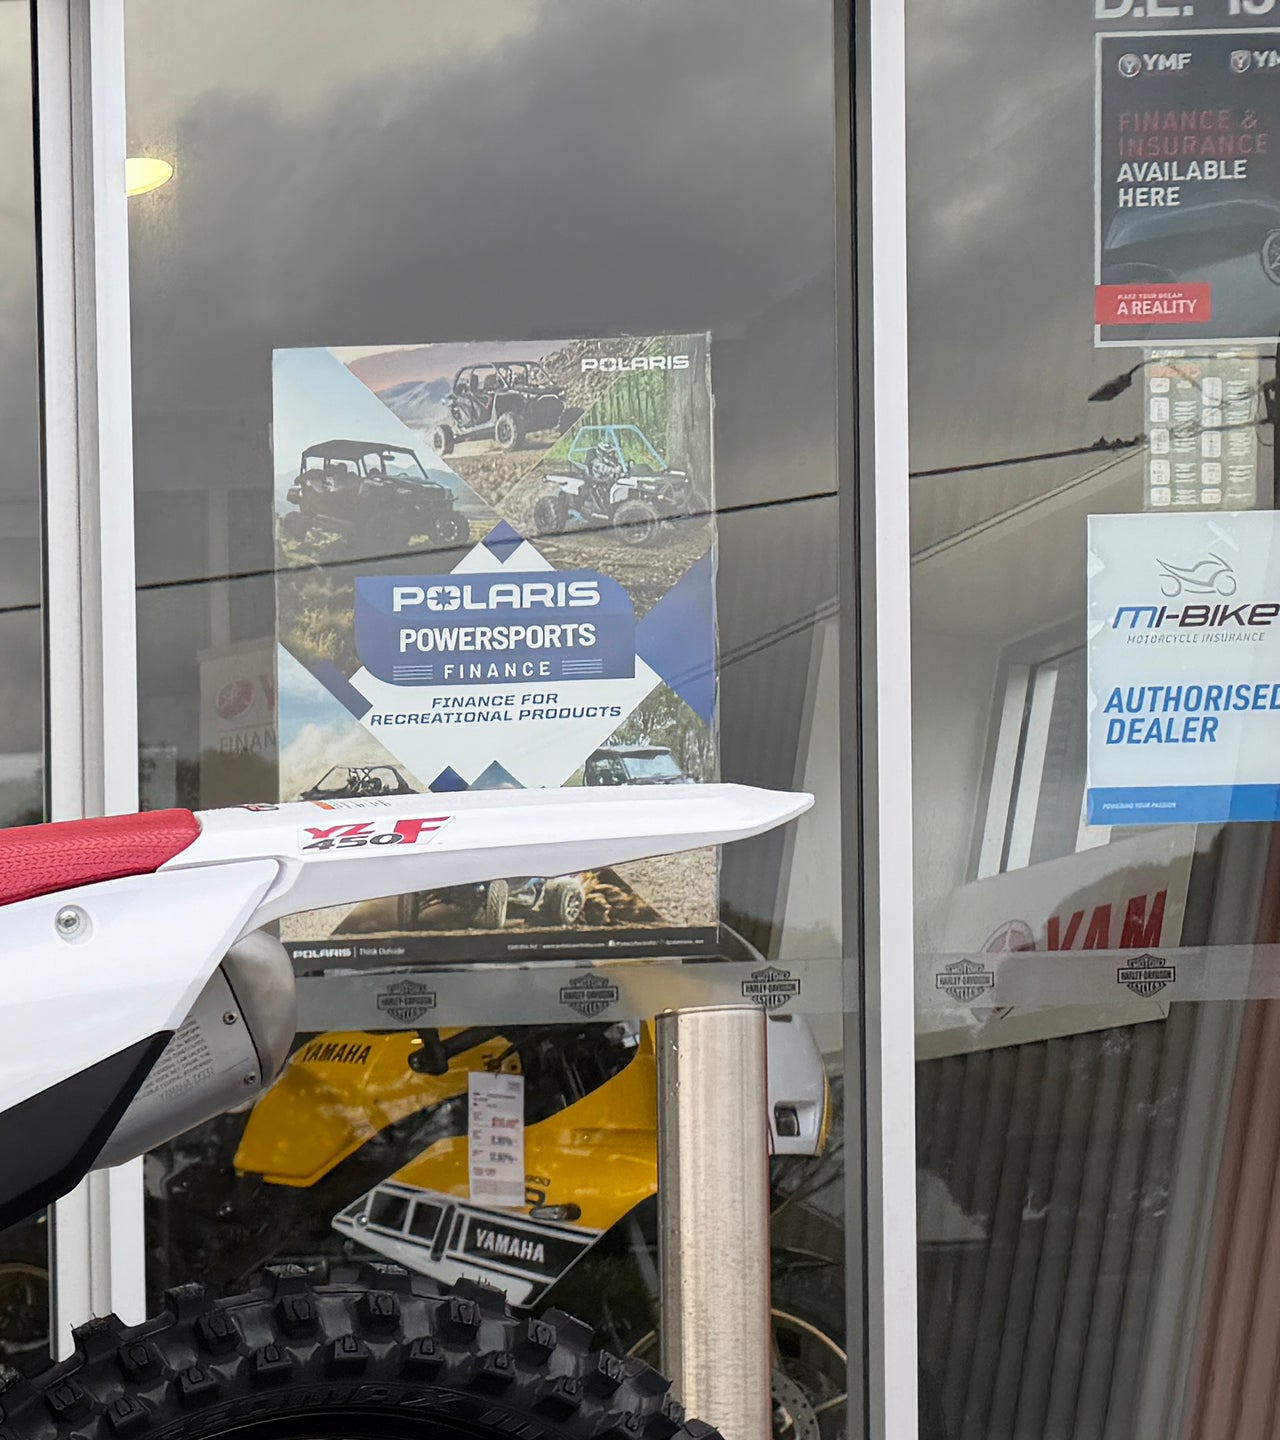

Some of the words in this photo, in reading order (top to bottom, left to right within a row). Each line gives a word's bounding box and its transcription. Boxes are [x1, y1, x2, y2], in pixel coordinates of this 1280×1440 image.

[1143, 53, 1192, 71] YMF
[1118, 110, 1230, 132] FINANCE
[1241, 109, 1258, 129] &
[1118, 133, 1269, 157] INSURANCE
[1116, 160, 1247, 183] AVAILABLE
[1118, 186, 1180, 207] HERE
[1117, 301, 1128, 316] A
[1132, 299, 1197, 316] REALITY
[581, 354, 690, 373] POLARIS
[393, 581, 601, 612] POLARIS
[399, 623, 597, 653] POWERSPORTS
[1127, 633, 1200, 644] MOTORCYCLE
[1202, 632, 1266, 643] INSURANCE
[444, 661, 552, 679] FINANCE
[431, 694, 516, 709] FINANCE
[521, 692, 559, 706] FOR
[370, 708, 513, 727] RECREATIONAL
[519, 705, 621, 721] PRODUCTS
[1106, 716, 1219, 744] DEALER
[293, 948, 352, 959] POLARIS
[302, 1042, 371, 1065] YAMAHA
[476, 1228, 545, 1263] YAMAHA
